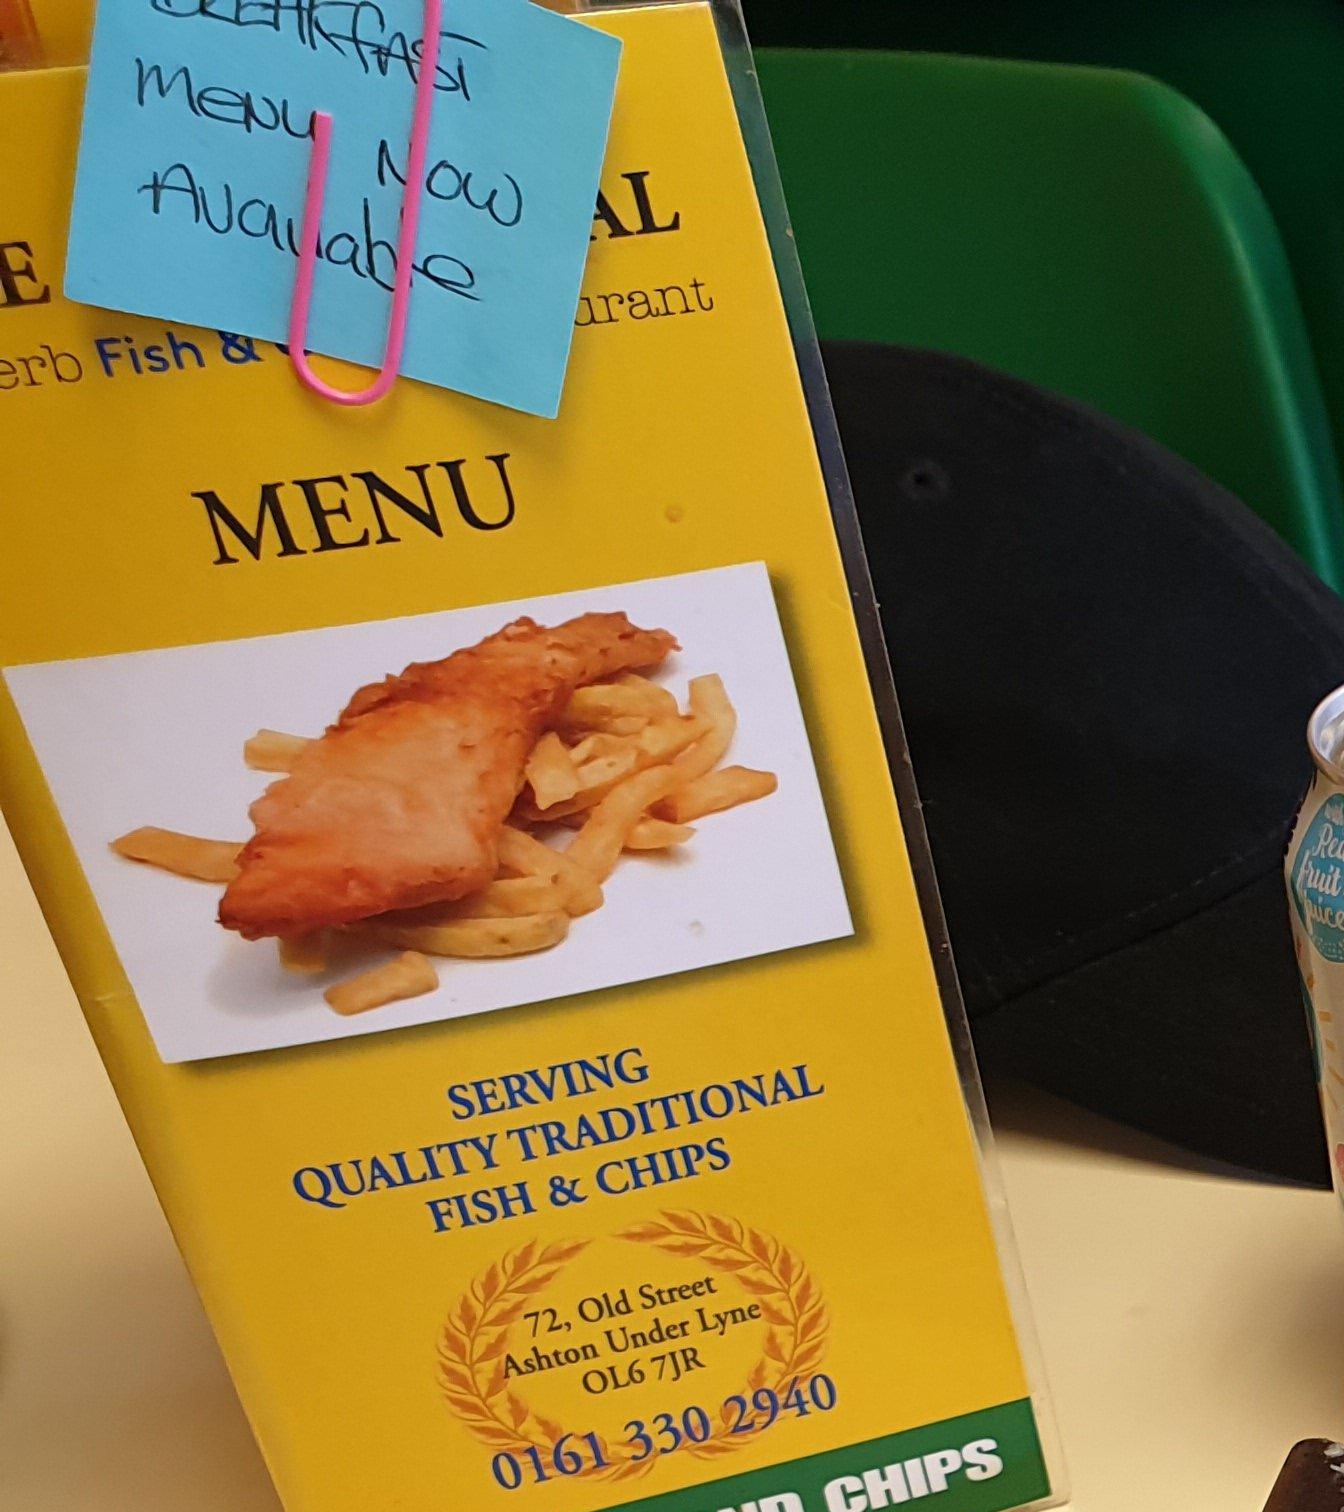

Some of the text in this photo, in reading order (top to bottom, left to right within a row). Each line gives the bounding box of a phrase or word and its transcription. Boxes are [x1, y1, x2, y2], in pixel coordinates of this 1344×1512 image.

[94, 331, 205, 378] Fish
[218, 330, 264, 365] &
[191, 453, 518, 566] MENU
[1296, 850, 1342, 898] fruit
[447, 1047, 650, 1120] SERVING
[292, 1063, 825, 1209] QUALITY TRADITIONAL
[425, 1137, 731, 1233] FISH & CHIPS
[503, 1303, 762, 1379] Ashton Under Lyne
[524, 1276, 718, 1338] 72, Old Street
[582, 1346, 707, 1395] OL6 7JR
[491, 1373, 837, 1490] 0161 330 2940
